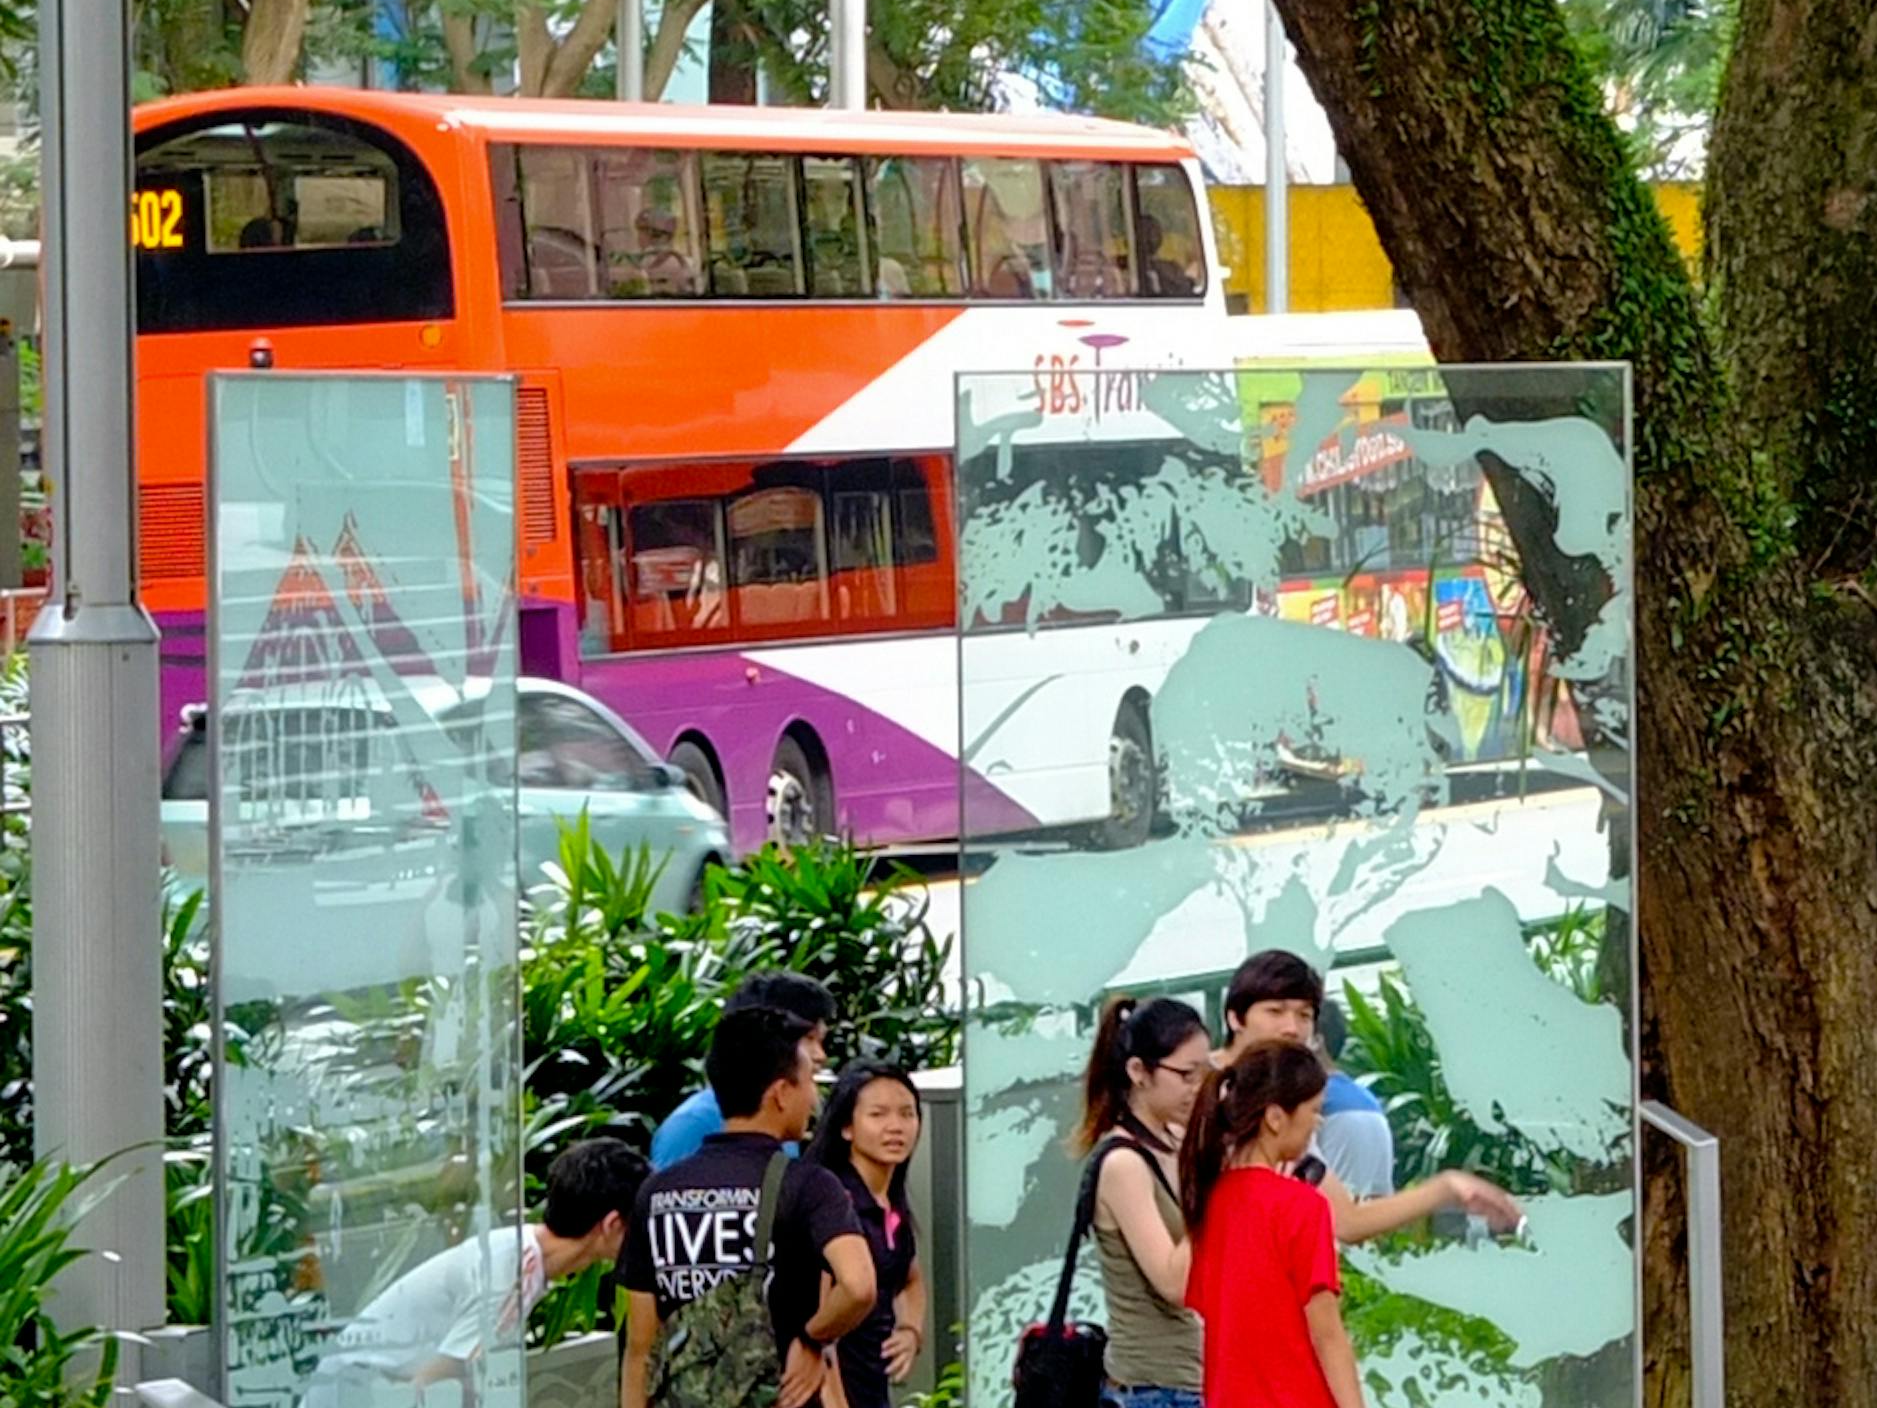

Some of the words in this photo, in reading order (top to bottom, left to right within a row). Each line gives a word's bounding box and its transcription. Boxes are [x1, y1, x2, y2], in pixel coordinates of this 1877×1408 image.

[1034, 354, 1082, 414] SBS
[650, 1187, 764, 1215] TRANSFORMIN
[647, 1210, 776, 1268] LIVES
